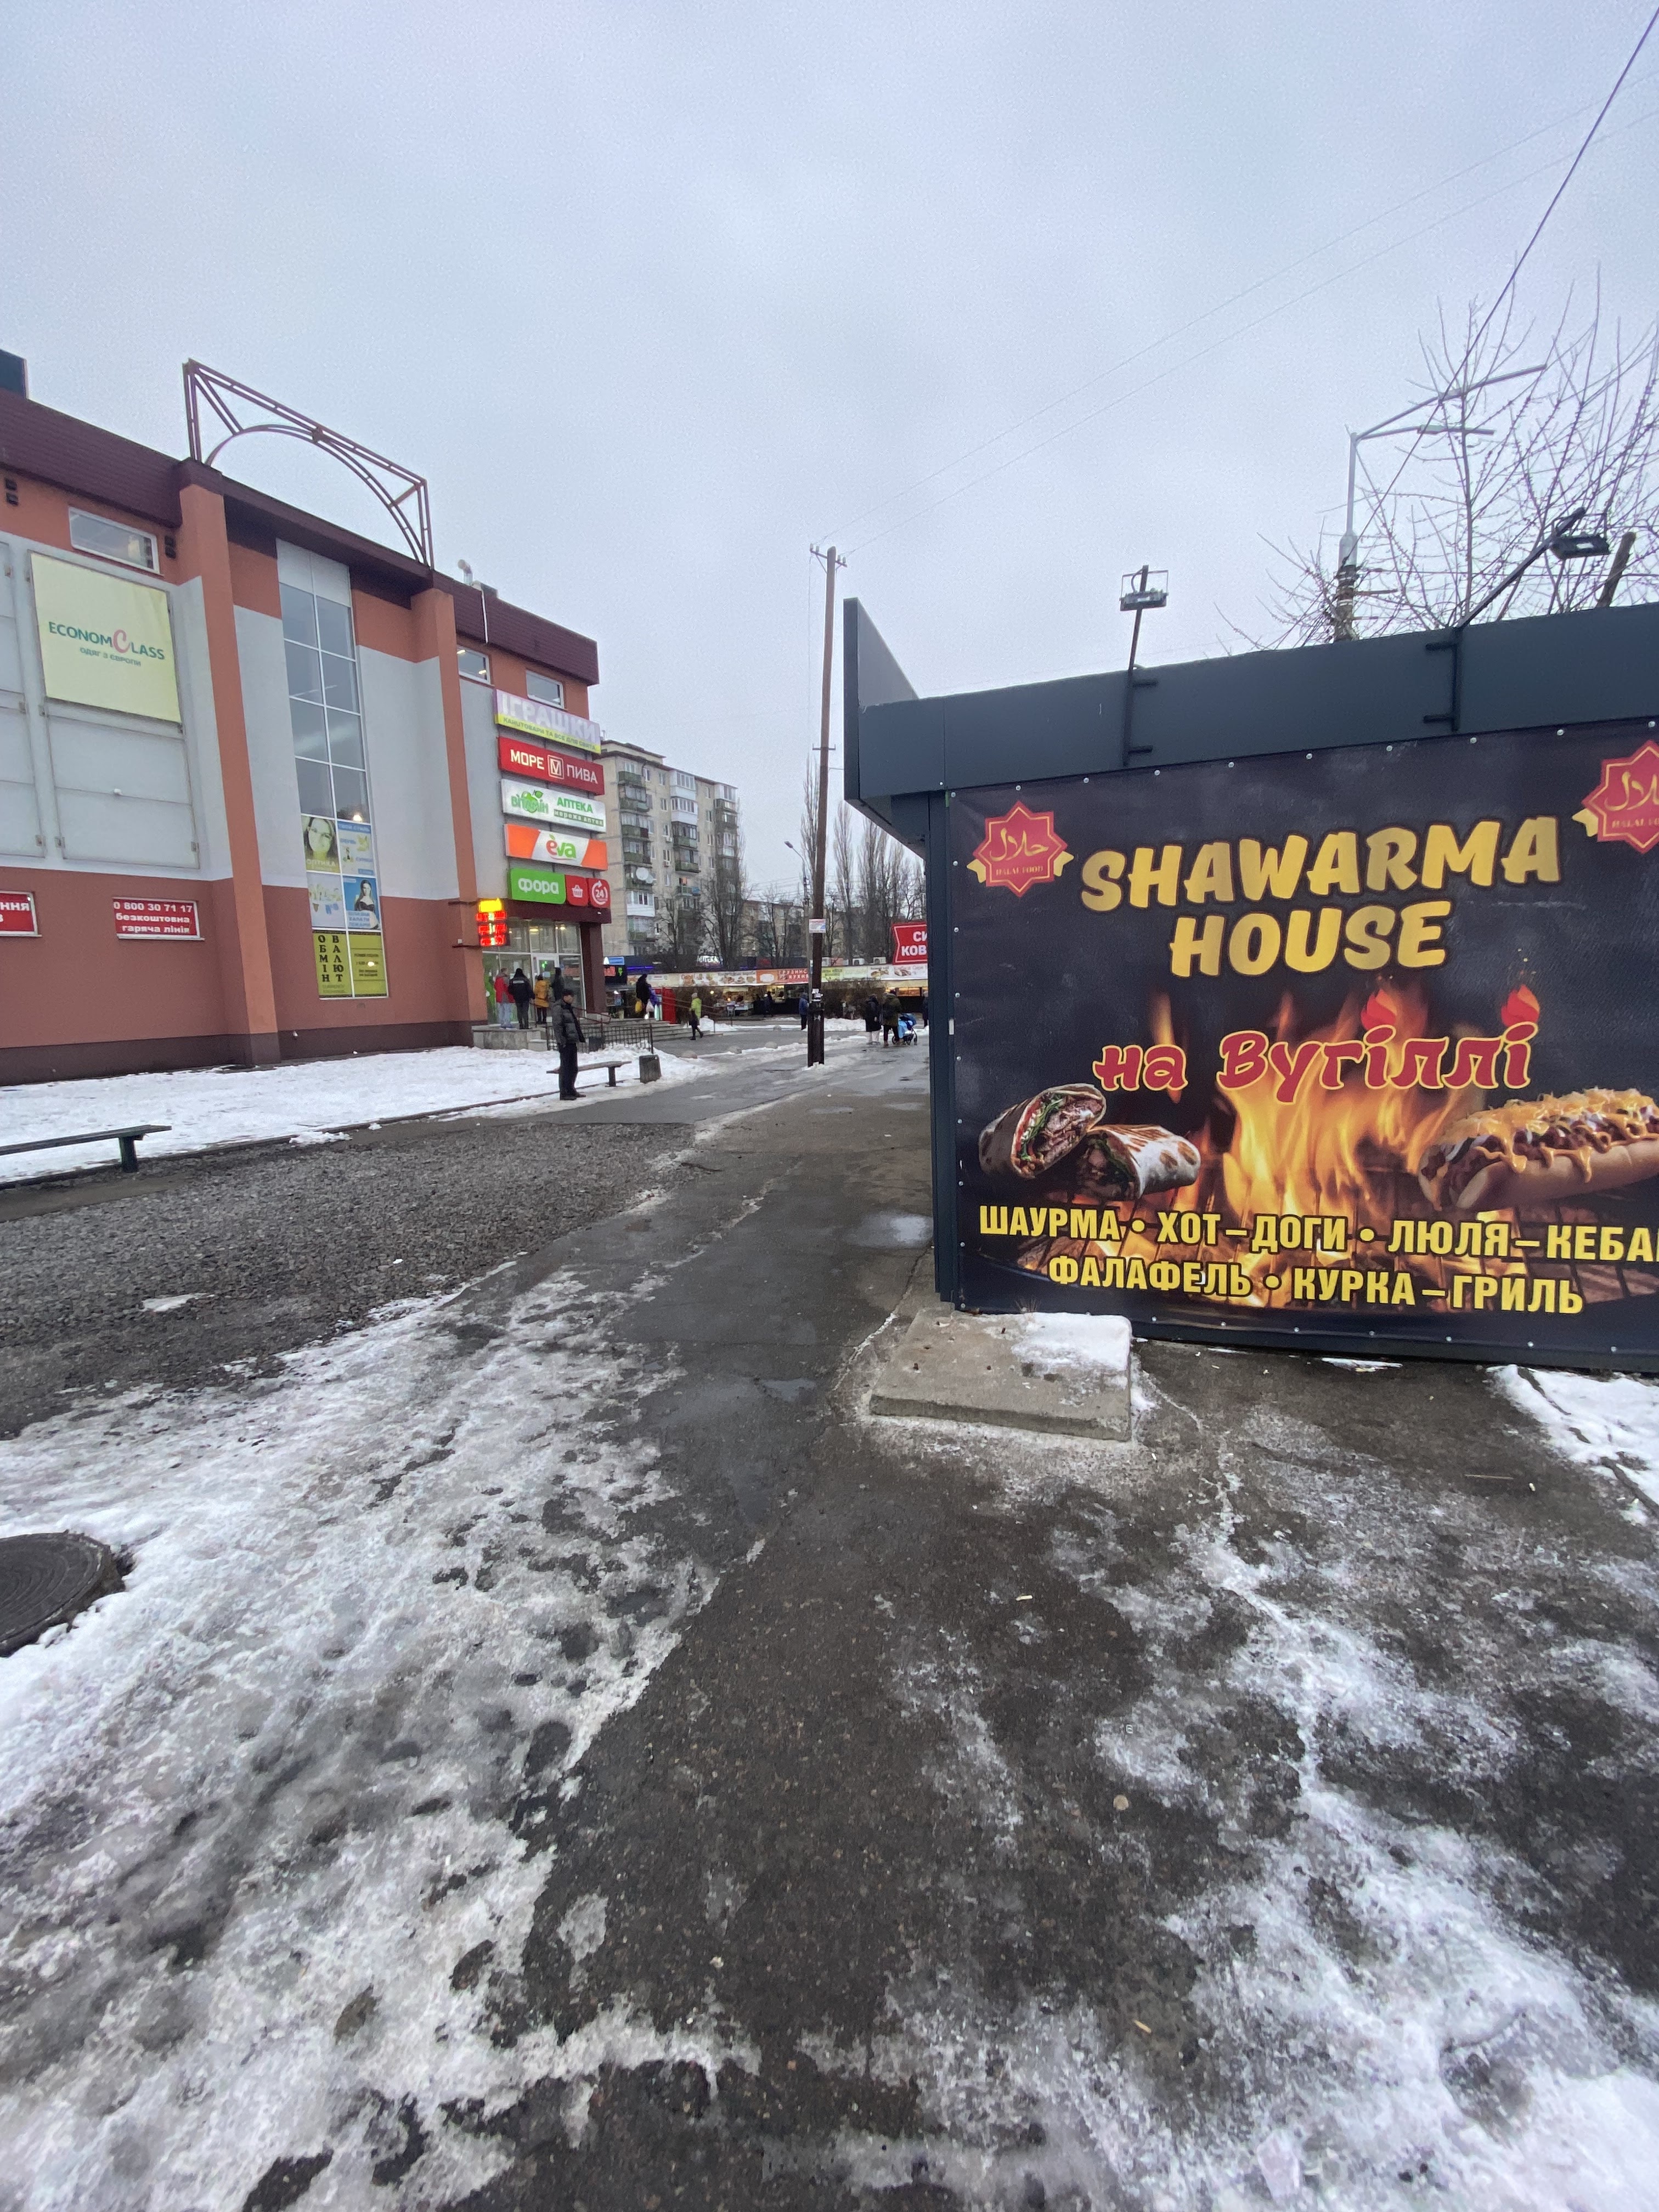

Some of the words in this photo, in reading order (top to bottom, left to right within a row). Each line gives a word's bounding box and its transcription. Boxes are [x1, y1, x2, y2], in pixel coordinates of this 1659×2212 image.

[502, 693, 596, 743] ІГРАШКИ
[510, 749, 545, 770] МОРЕ
[566, 764, 599, 785] ПИВА
[557, 797, 594, 814] АПТЕКА
[1081, 815, 1560, 912] SHAWARMA
[113, 901, 121, 910] 0
[124, 902, 144, 911] 800
[148, 903, 161, 911] 30
[180, 905, 192, 913] 17
[595, 889, 604, 898] 24
[116, 912, 190, 923] безкоштовна
[122, 925, 161, 933] гаряча
[901, 944, 927, 956] КОВ
[1169, 899, 1452, 978] HOUSE
[318, 935, 330, 982] ОБМІН
[332, 935, 344, 982] ВАЛЮТ
[1092, 1044, 1189, 1092] на
[1216, 1021, 1538, 1105] Вугіллі
[979, 1205, 1121, 1241] ШАУРМА
[1048, 1255, 1252, 1297] ФАЛАФЕЛЬ
